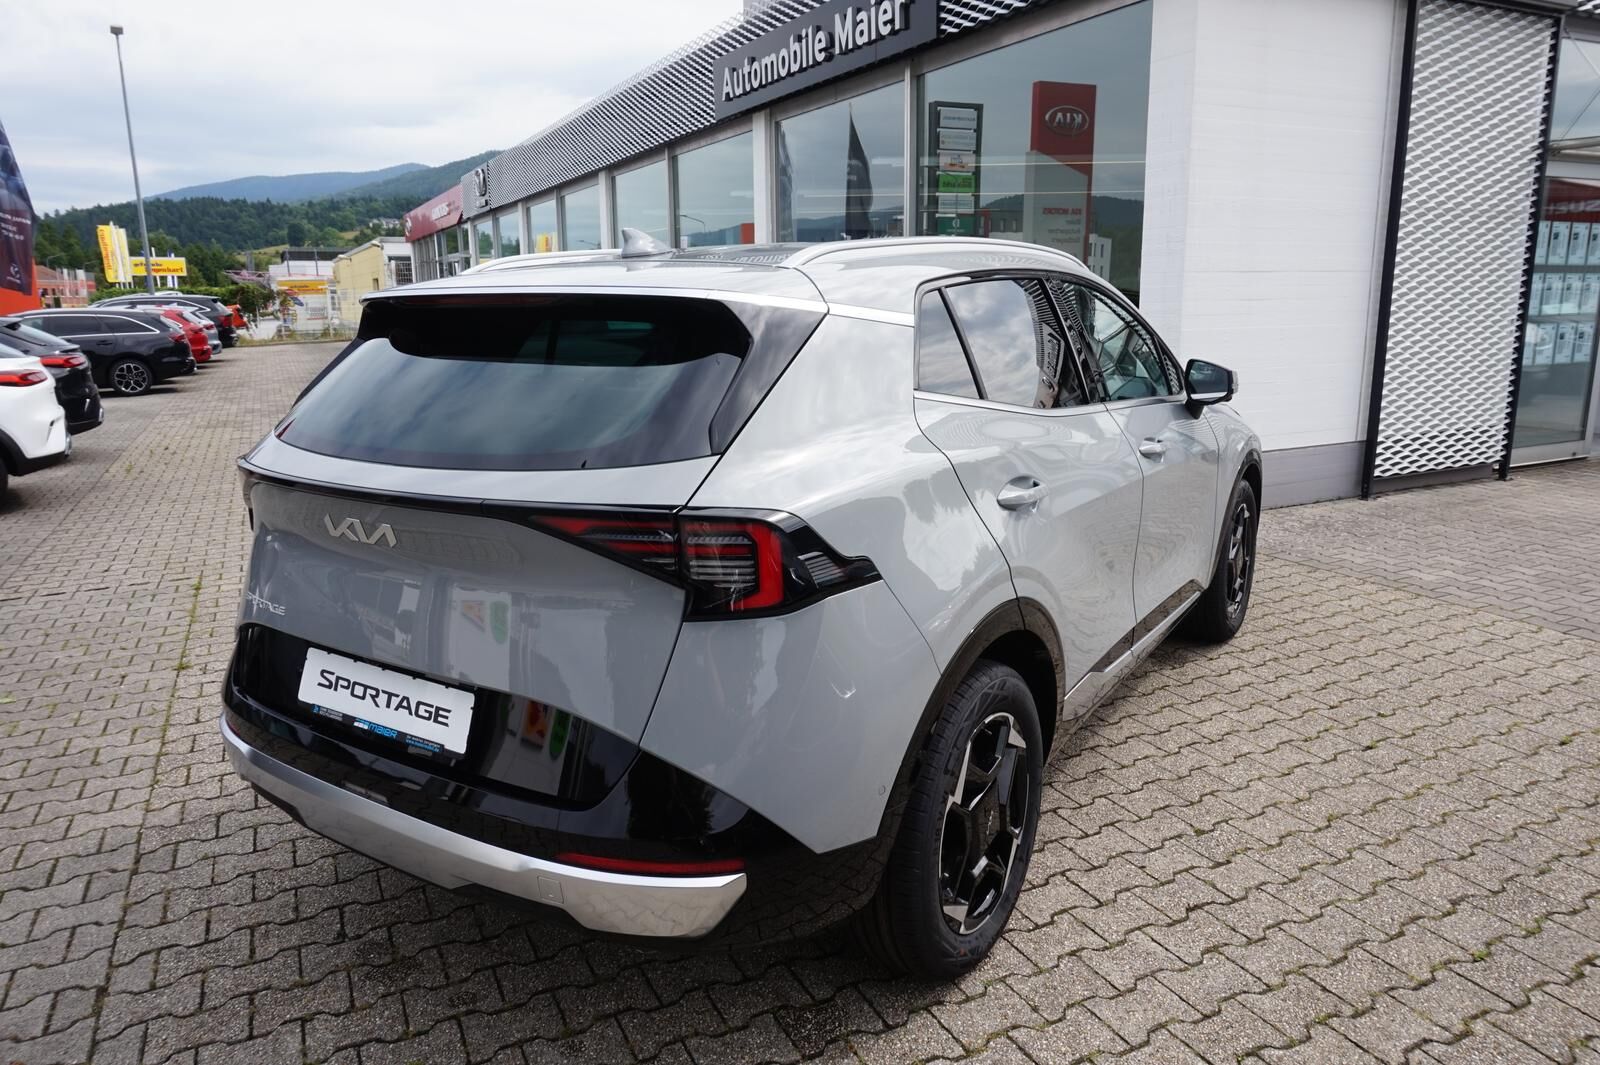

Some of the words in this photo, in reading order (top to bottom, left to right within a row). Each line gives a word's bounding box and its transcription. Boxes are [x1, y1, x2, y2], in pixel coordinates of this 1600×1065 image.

[721, 24, 827, 102] Automobile
[834, 0, 906, 55] Maier
[323, 513, 398, 549] KIA
[316, 668, 453, 728] SPORTAGE
